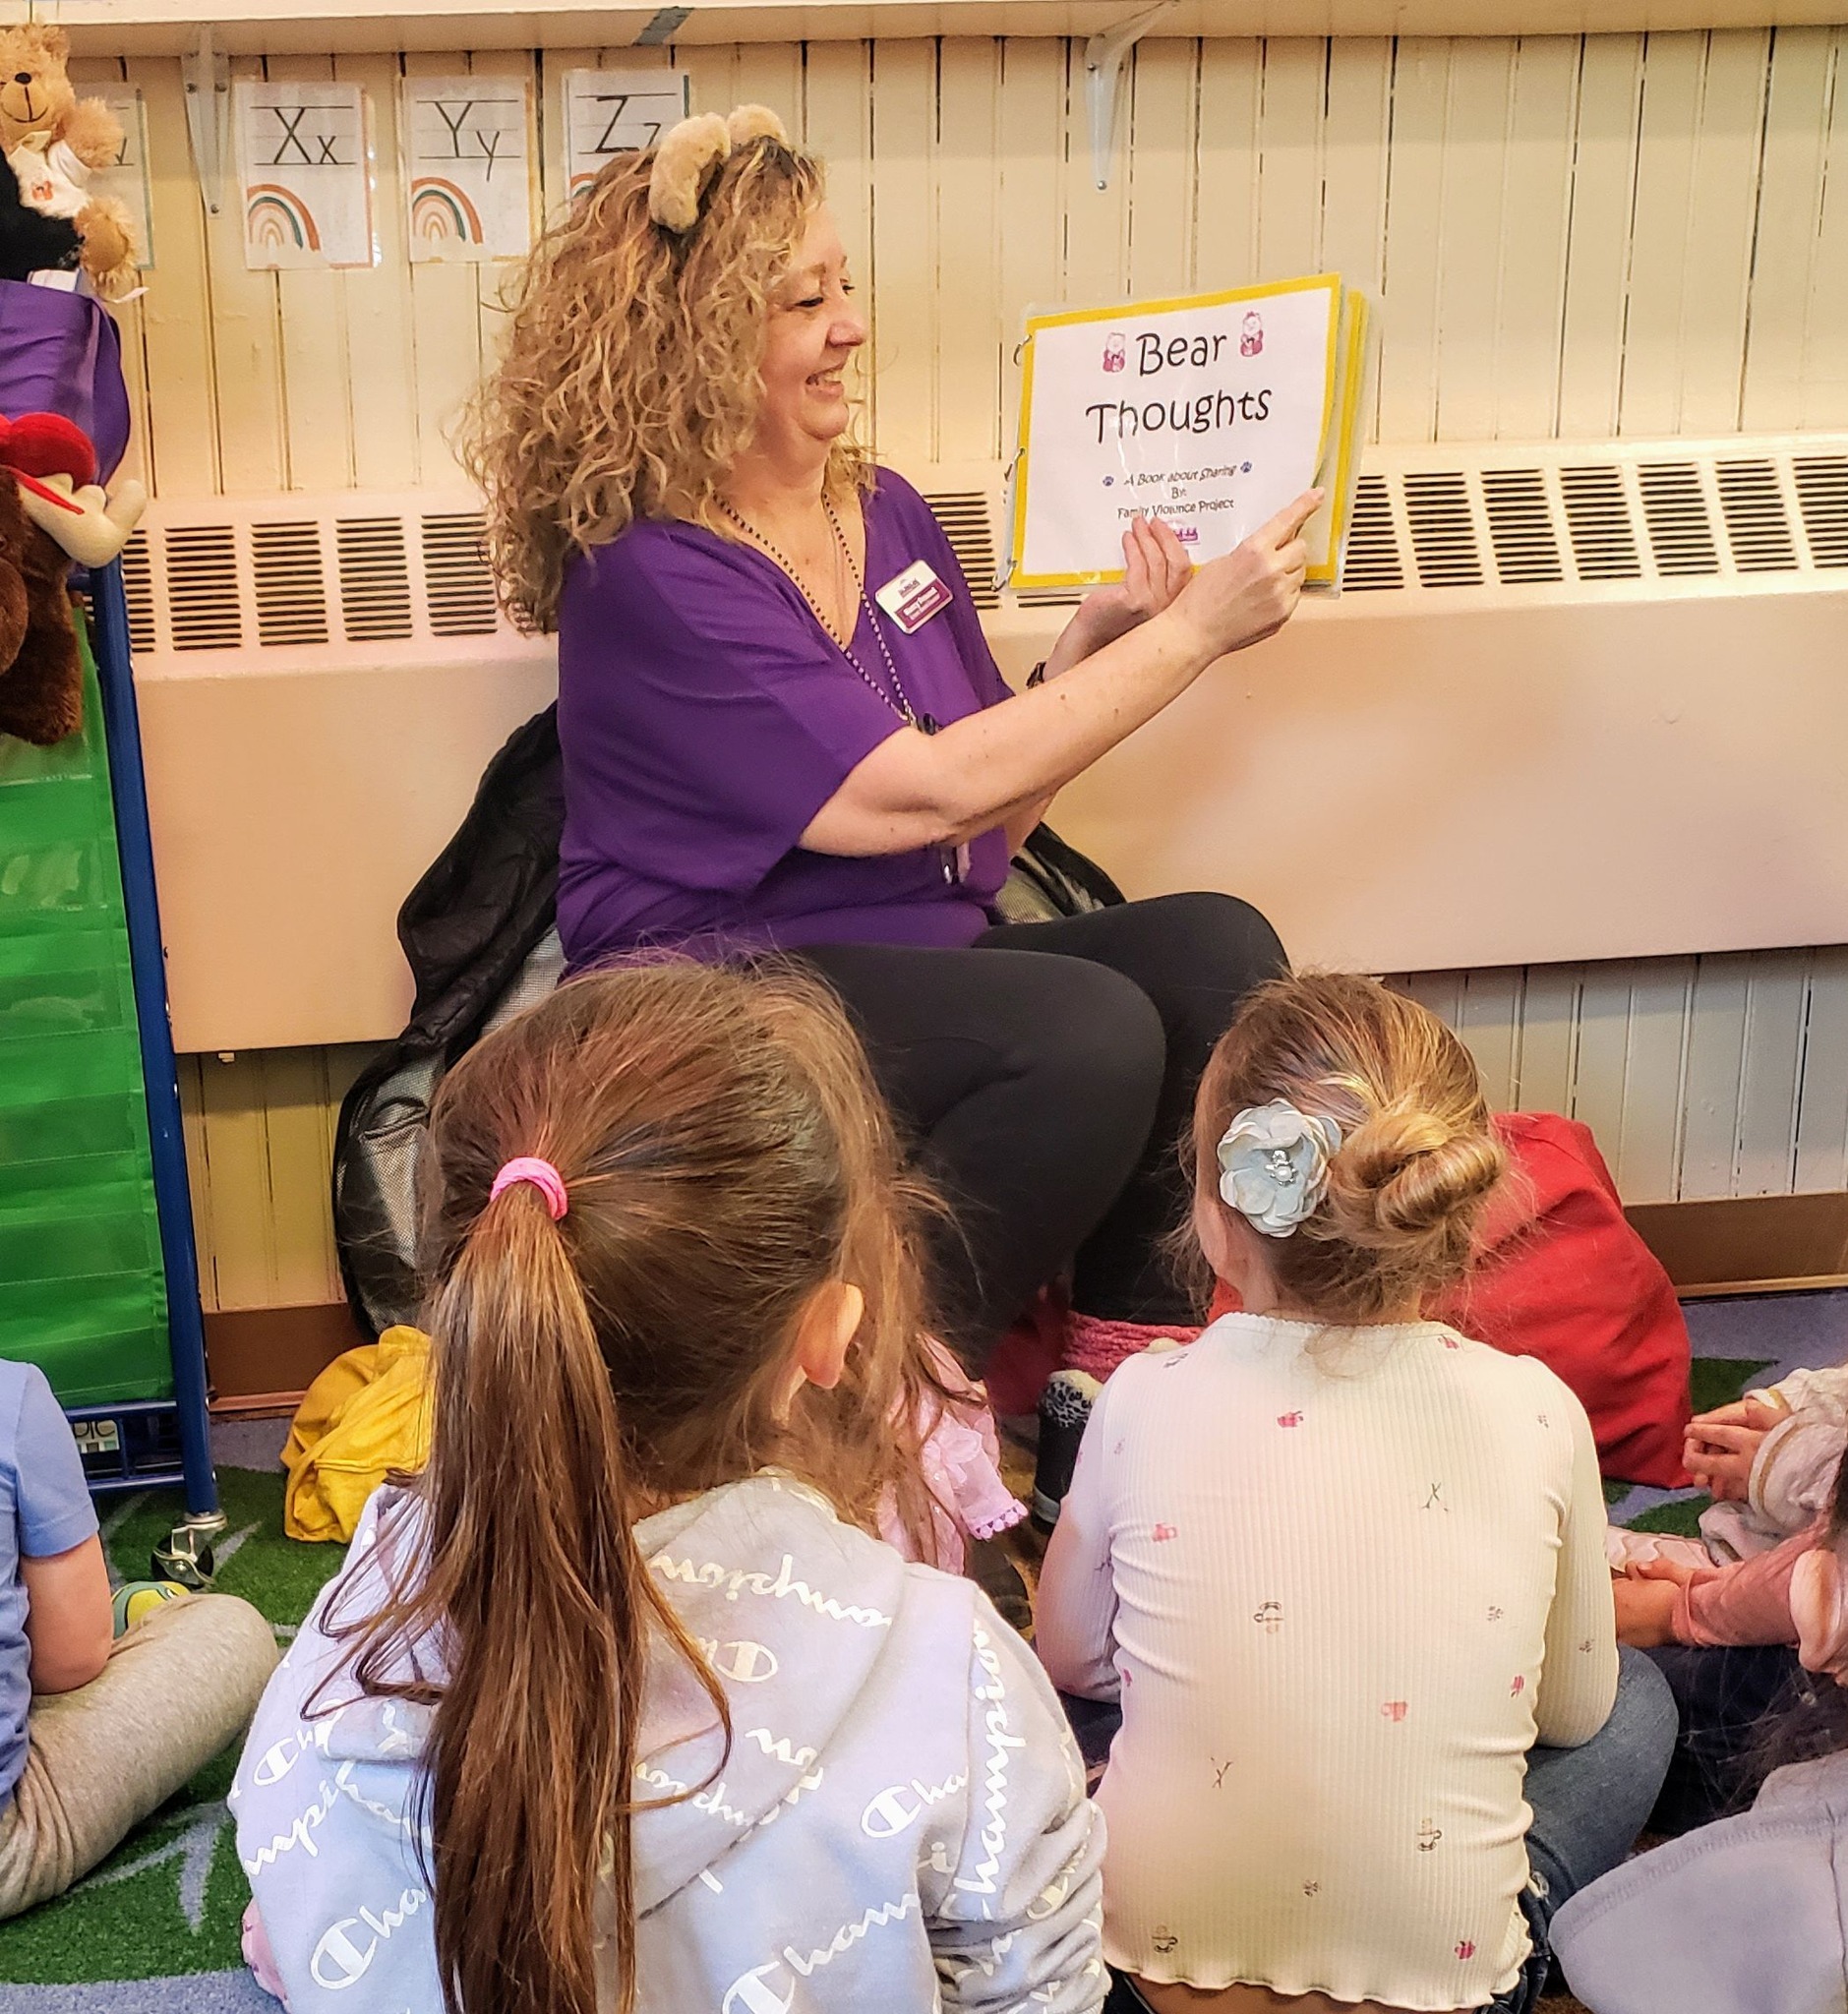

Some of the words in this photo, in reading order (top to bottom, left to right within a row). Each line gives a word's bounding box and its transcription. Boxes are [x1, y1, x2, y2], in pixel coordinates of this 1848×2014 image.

[273, 106, 337, 165] Xx
[434, 100, 501, 182] Yy
[1136, 331, 1227, 377] Bear
[1086, 389, 1273, 444] Thoughts
[1123, 473, 1134, 487] A
[1137, 473, 1165, 486] Book
[1166, 470, 1199, 483] about
[1199, 464, 1237, 481] Sharing
[1117, 504, 1149, 519] Faily
[1152, 502, 1197, 517] Violence
[1198, 499, 1235, 514] Project
